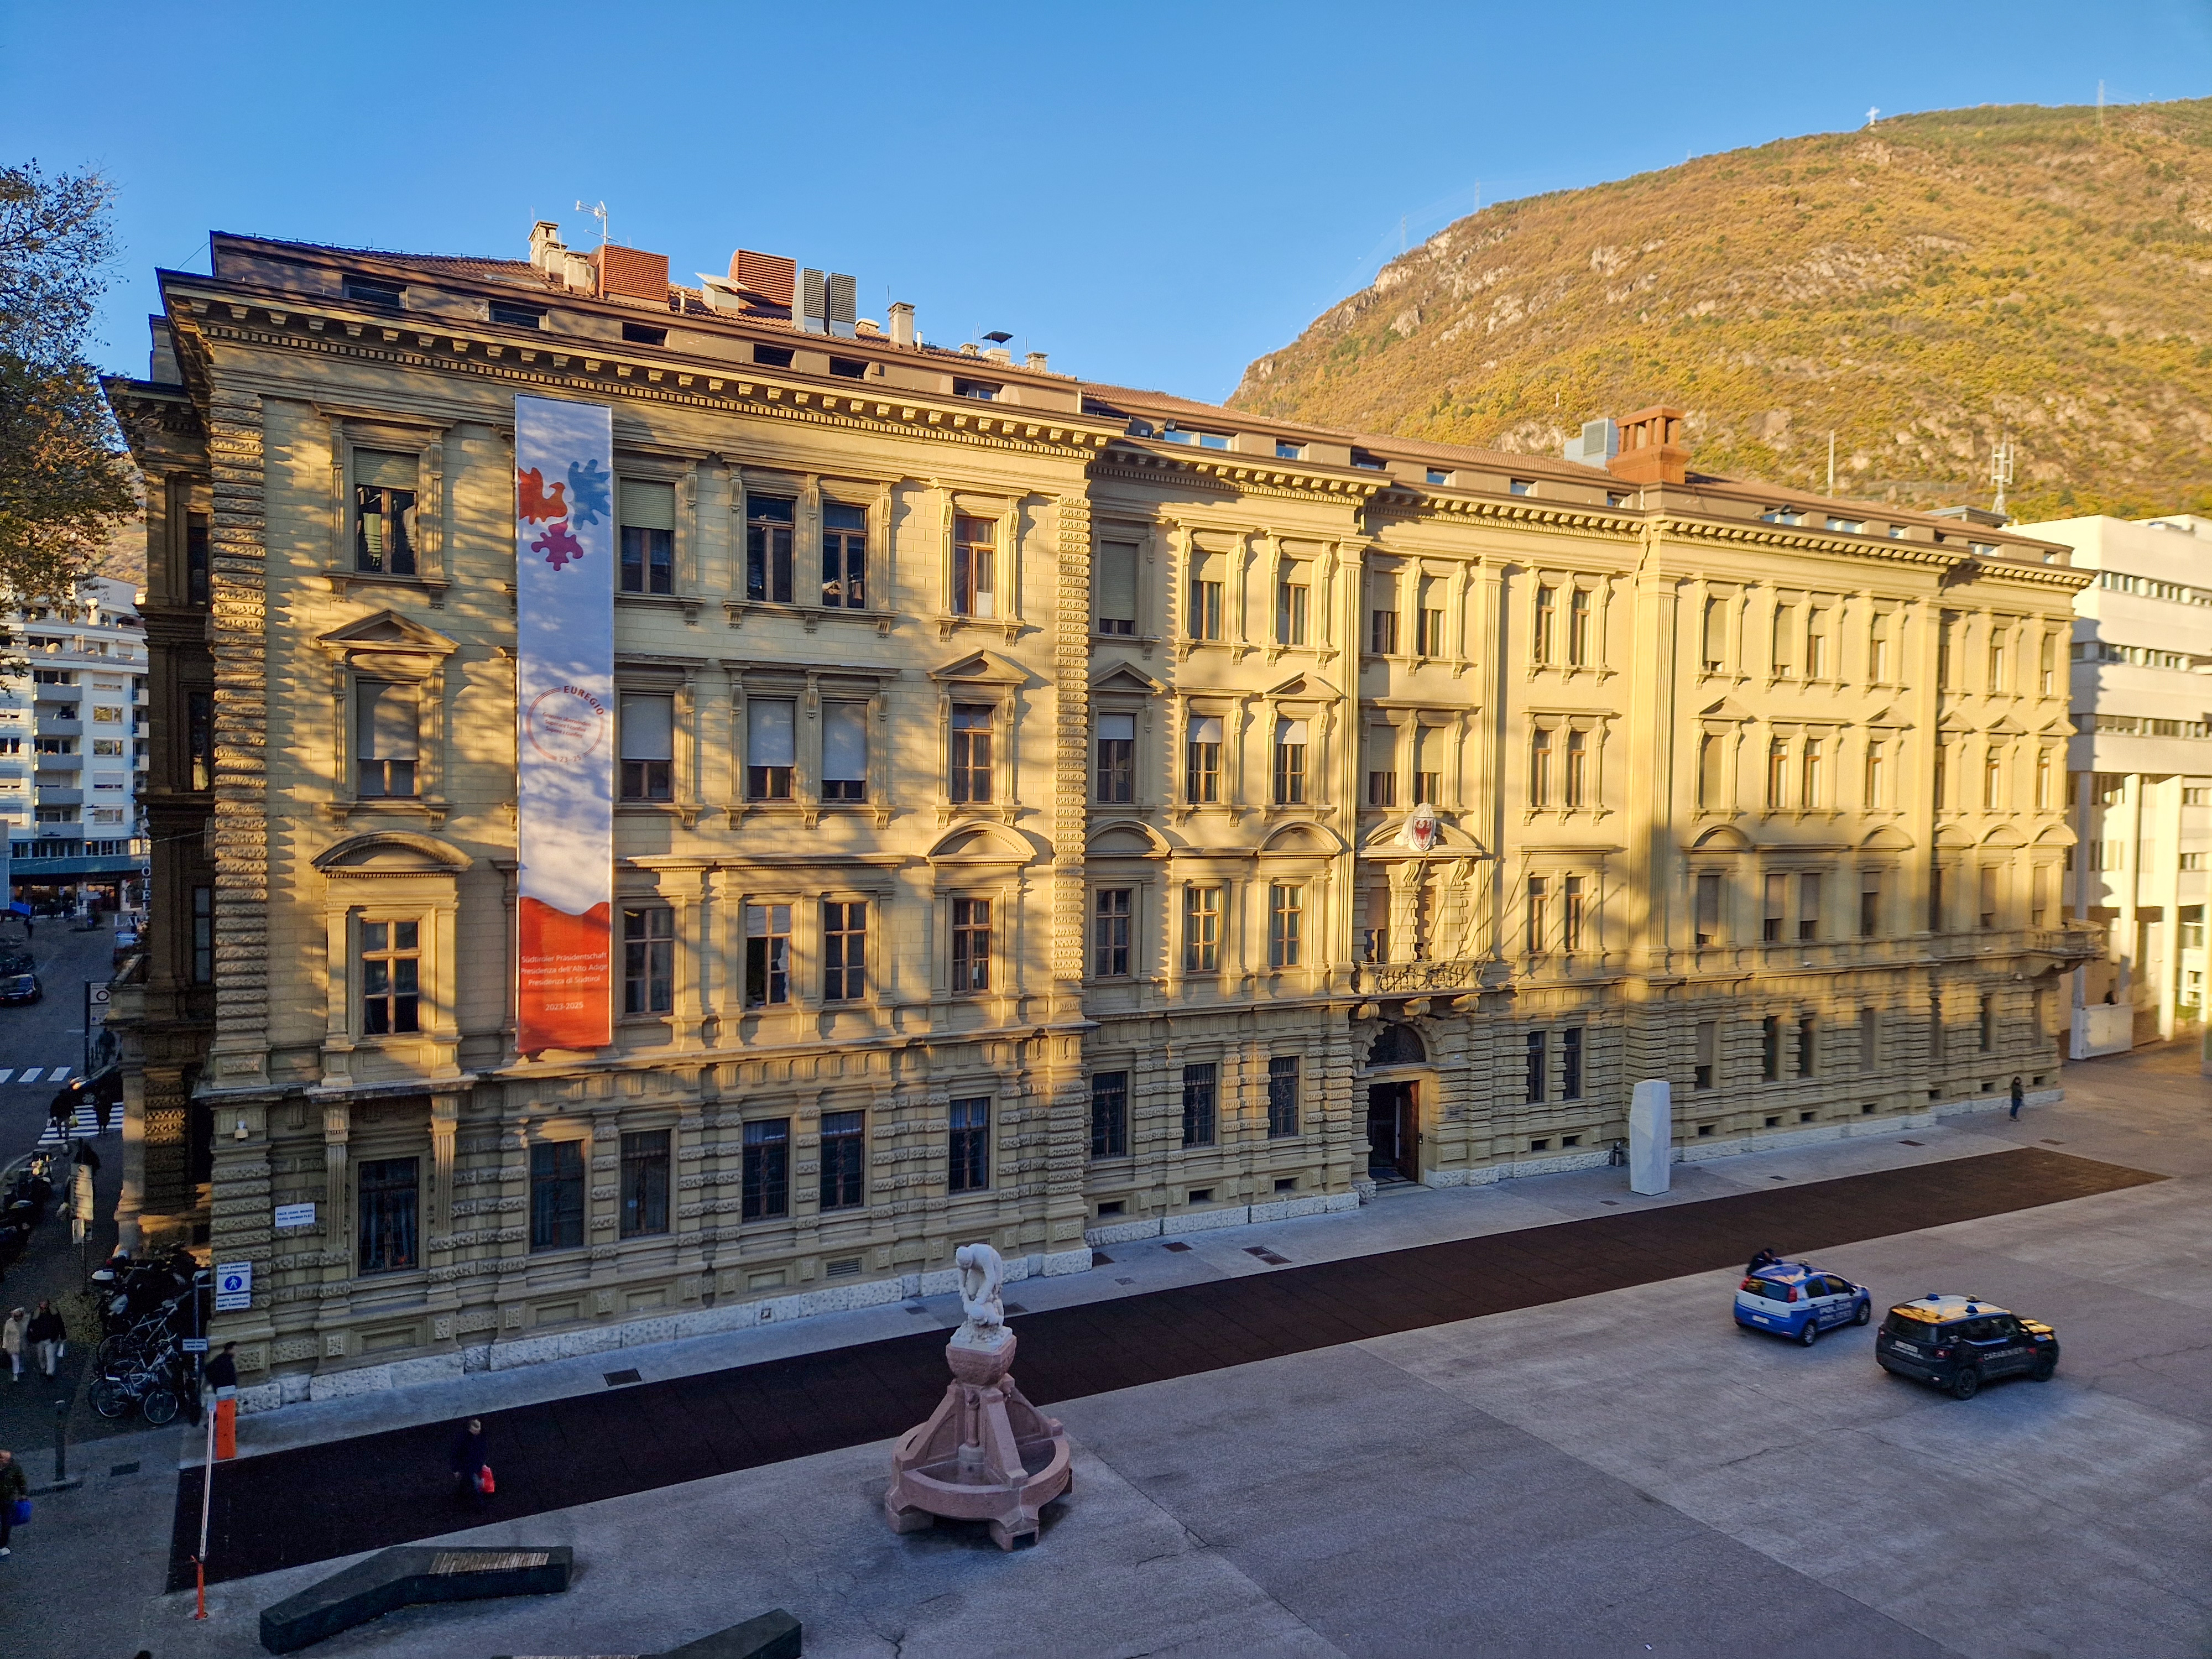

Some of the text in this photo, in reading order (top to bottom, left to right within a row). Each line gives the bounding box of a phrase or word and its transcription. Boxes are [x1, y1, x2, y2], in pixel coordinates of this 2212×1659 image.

[564, 685, 604, 715] EUREGIO
[556, 951, 607, 962] Präsidentschaft
[588, 963, 608, 972] Adige
[545, 1001, 584, 1011] 2023-2025
